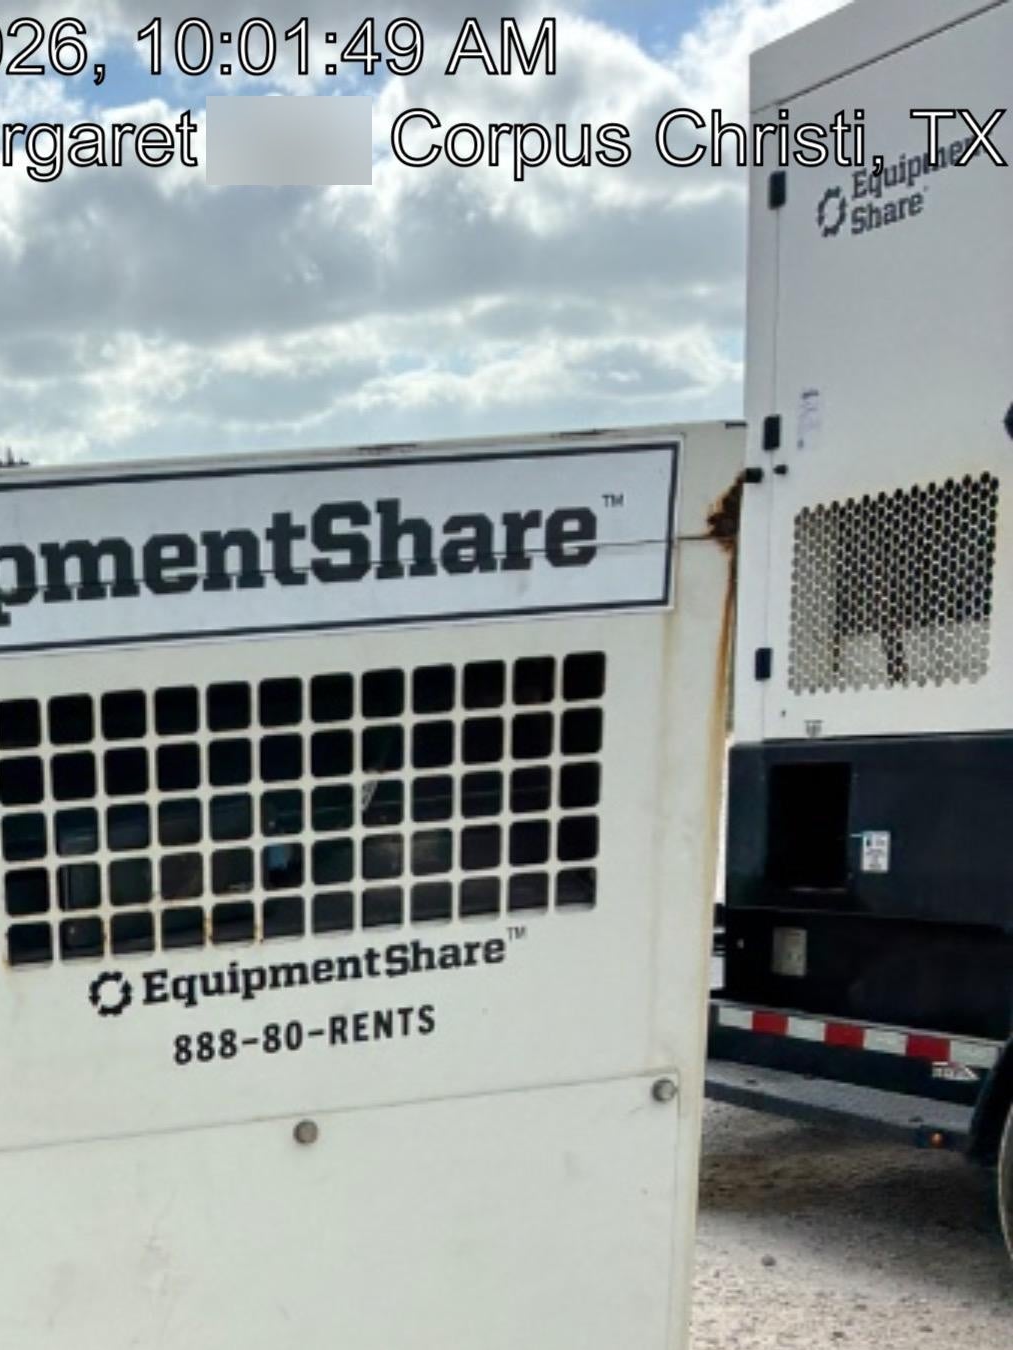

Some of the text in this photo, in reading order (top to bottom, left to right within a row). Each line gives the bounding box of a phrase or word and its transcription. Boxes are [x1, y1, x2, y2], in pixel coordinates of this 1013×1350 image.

[851, 192, 924, 235] Share
[142, 937, 505, 1007] EquipmentShare
[173, 1004, 436, 1065] 888-80-RENTS
